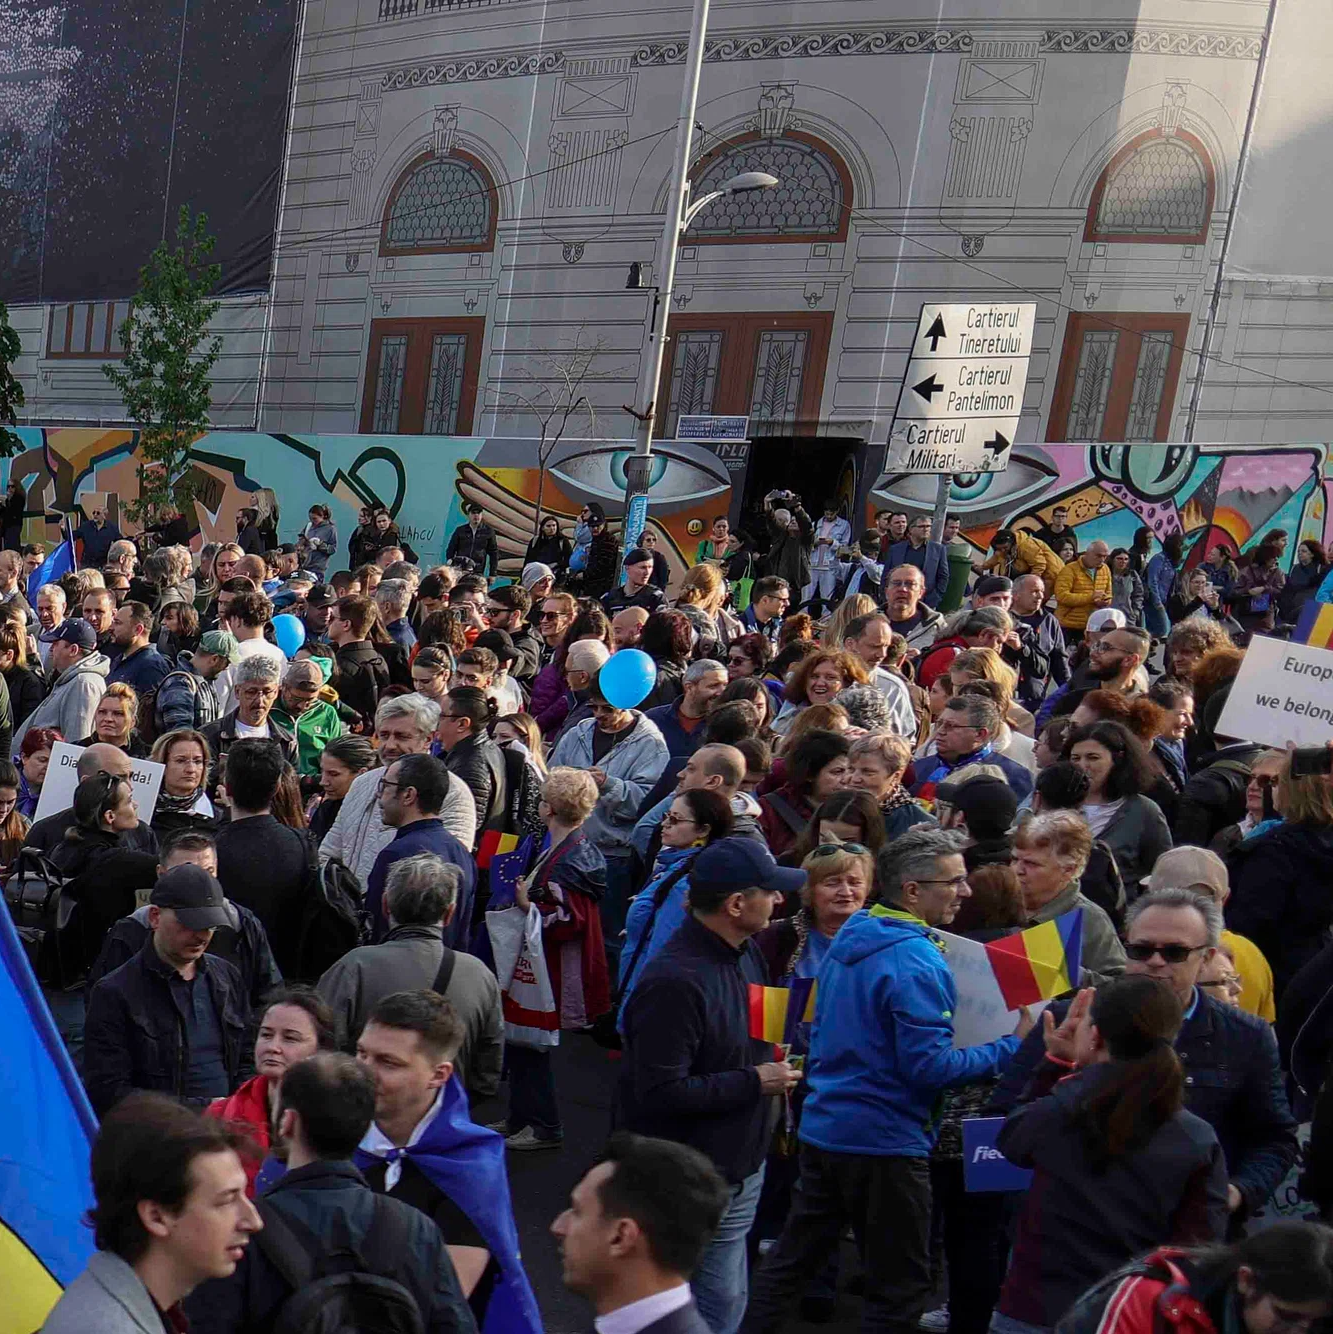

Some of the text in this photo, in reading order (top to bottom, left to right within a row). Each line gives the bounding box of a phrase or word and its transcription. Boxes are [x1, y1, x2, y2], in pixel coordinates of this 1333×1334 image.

[967, 307, 1021, 329] Cartierul
[959, 332, 1022, 354] Tineretului
[958, 365, 1013, 386] Cartierul
[947, 391, 1015, 412] Pantelimon
[906, 423, 967, 445] Cartierul
[906, 448, 957, 470] Militari
[1283, 656, 1333, 682] Europ
[1256, 693, 1280, 709] we
